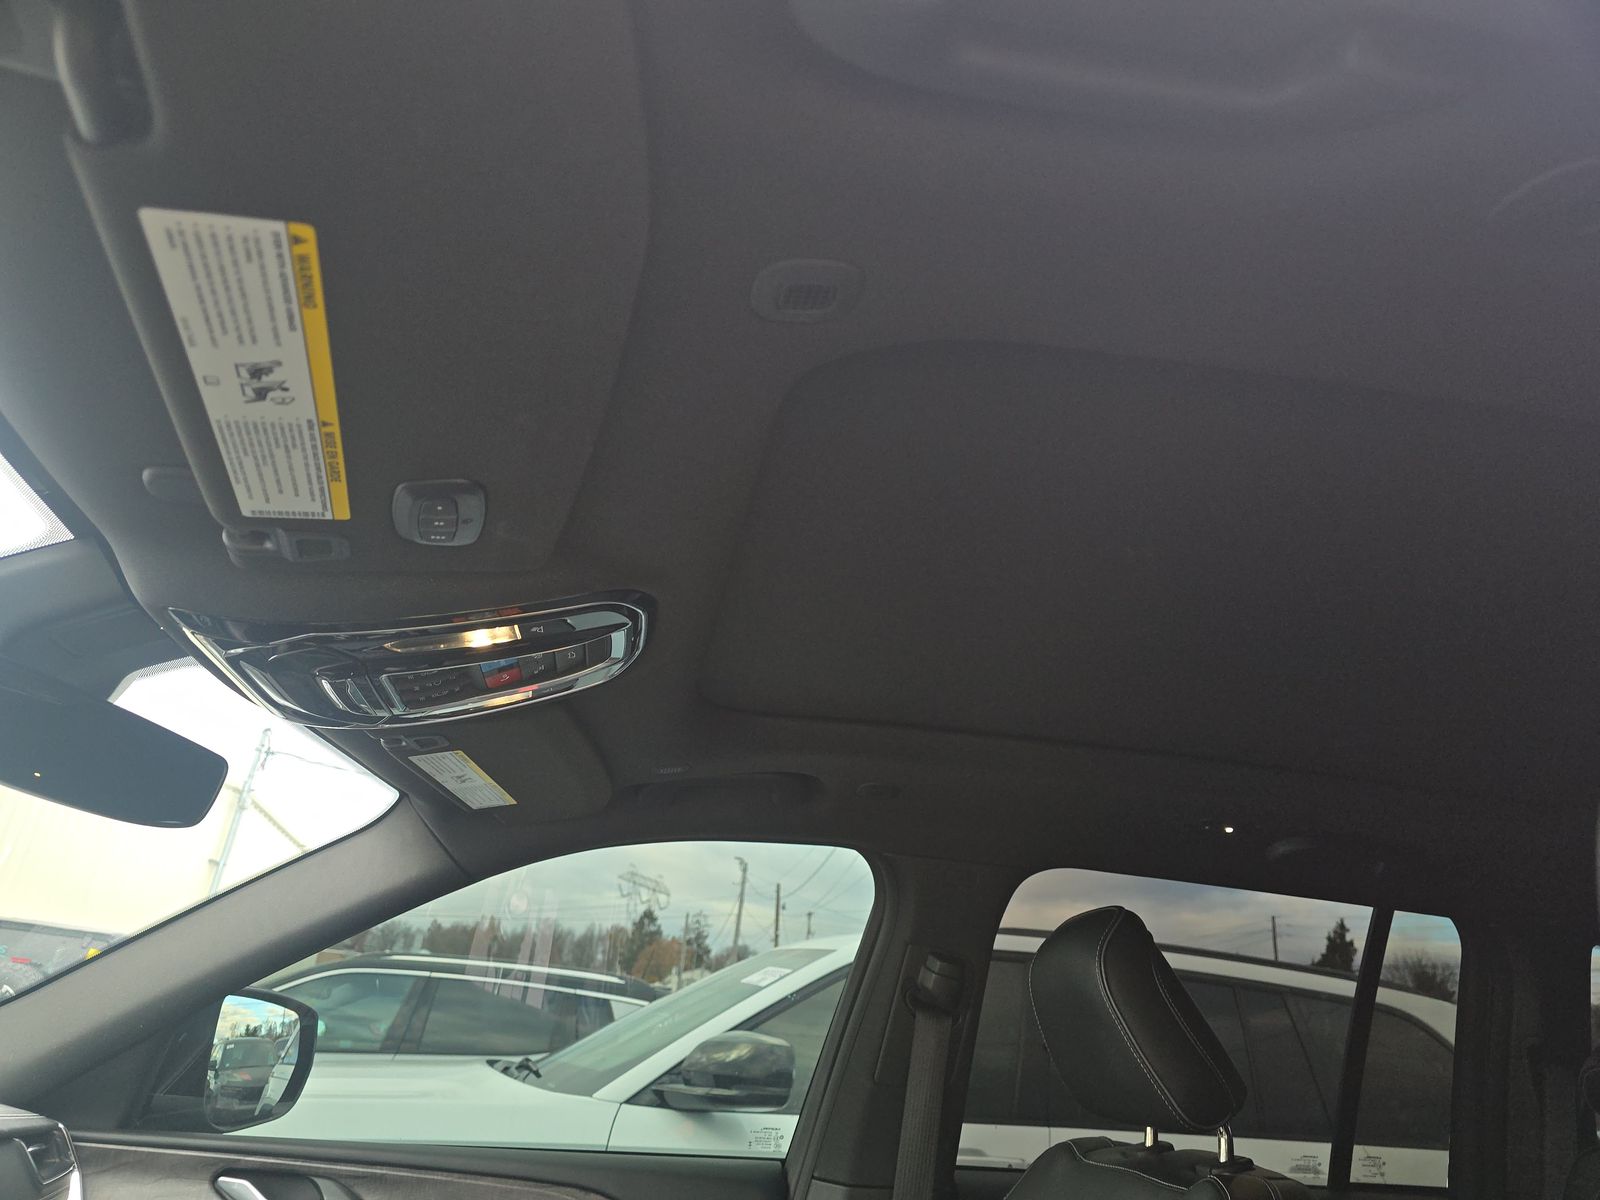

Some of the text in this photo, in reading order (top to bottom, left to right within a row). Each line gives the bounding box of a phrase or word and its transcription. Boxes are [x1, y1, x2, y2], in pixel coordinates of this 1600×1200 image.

[299, 254, 318, 310] WARNING
[323, 431, 341, 483] MISE EN GARDE
